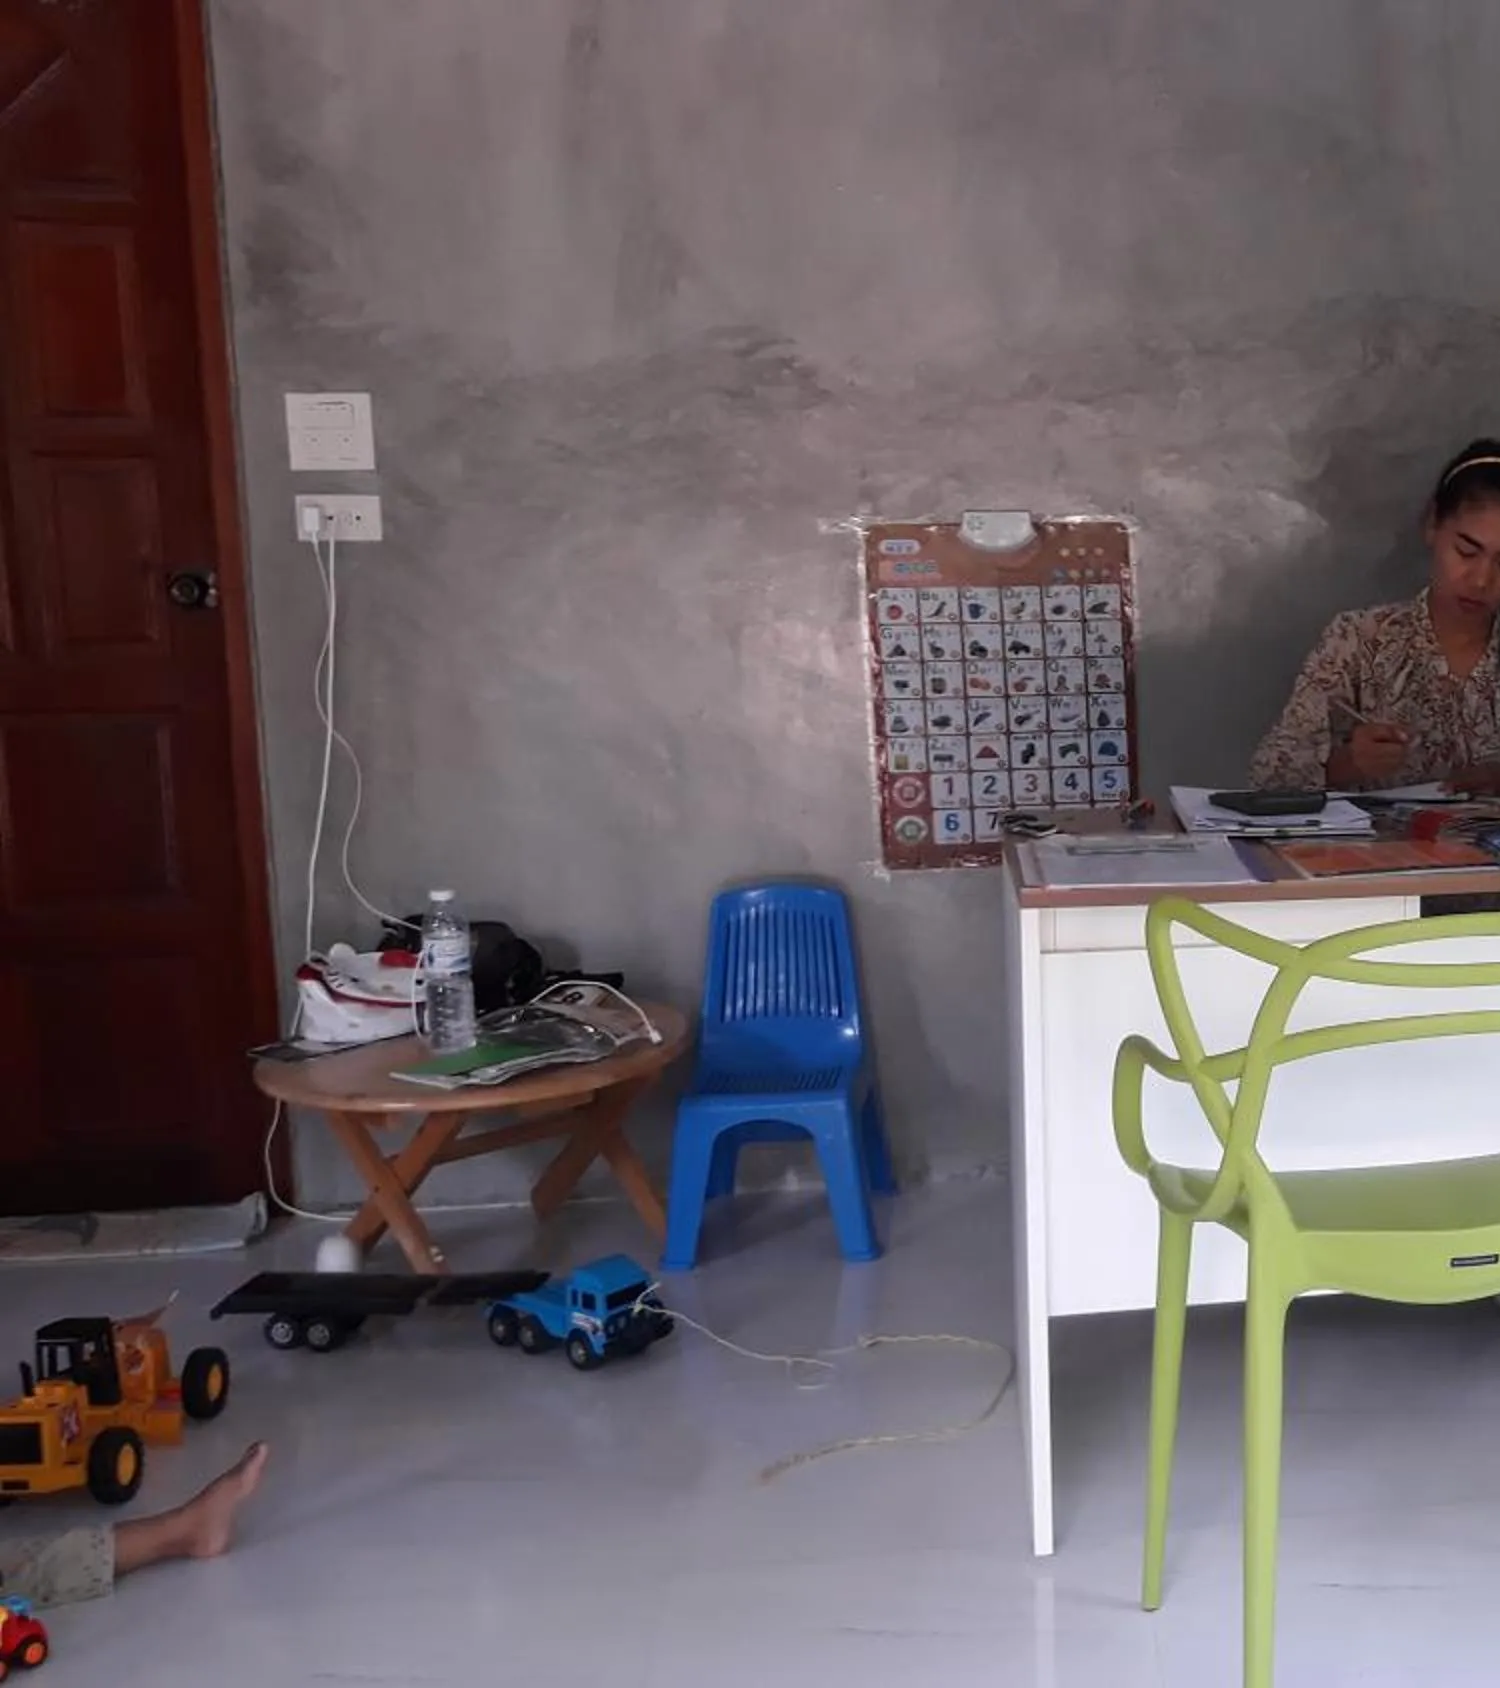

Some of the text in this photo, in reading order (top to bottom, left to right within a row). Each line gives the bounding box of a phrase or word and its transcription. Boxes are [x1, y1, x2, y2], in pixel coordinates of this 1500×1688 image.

[943, 776, 954, 796] 1
[983, 775, 998, 796] 2
[1024, 773, 1039, 793] 3
[1064, 771, 1079, 791] 4
[1103, 770, 1118, 790] 5
[945, 814, 959, 832] 6
[987, 811, 999, 831] 7
